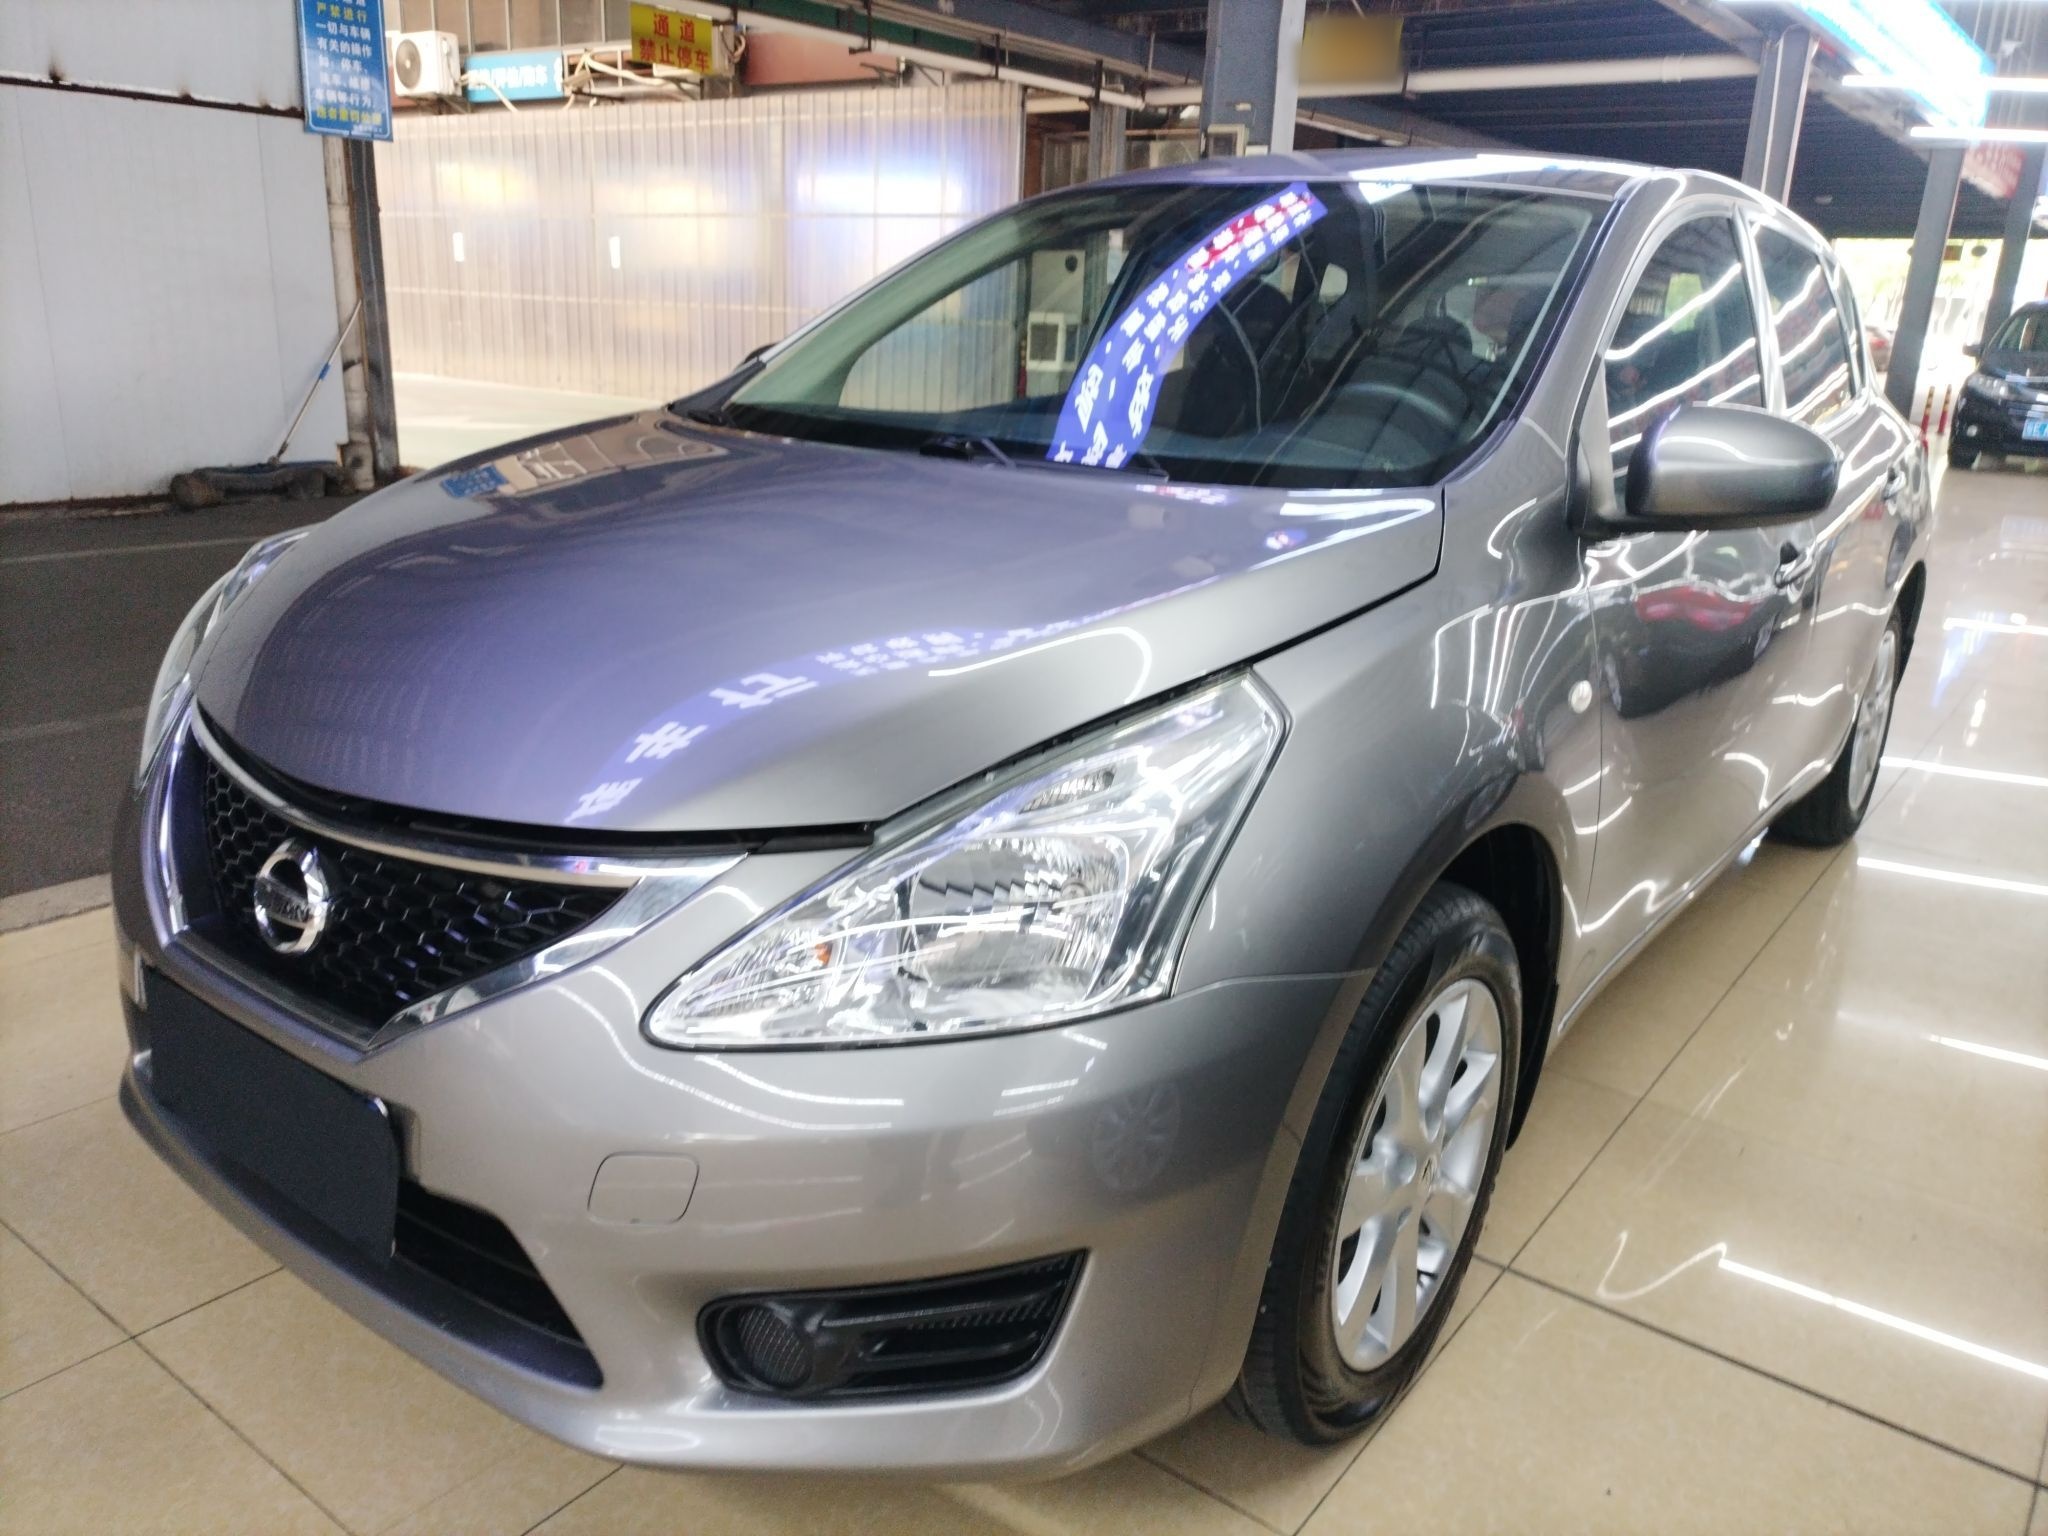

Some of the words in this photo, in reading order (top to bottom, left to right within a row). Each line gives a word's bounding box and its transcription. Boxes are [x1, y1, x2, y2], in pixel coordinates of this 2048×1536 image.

[653, 12, 695, 43] 通道
[639, 37, 710, 72] 禁止停车
